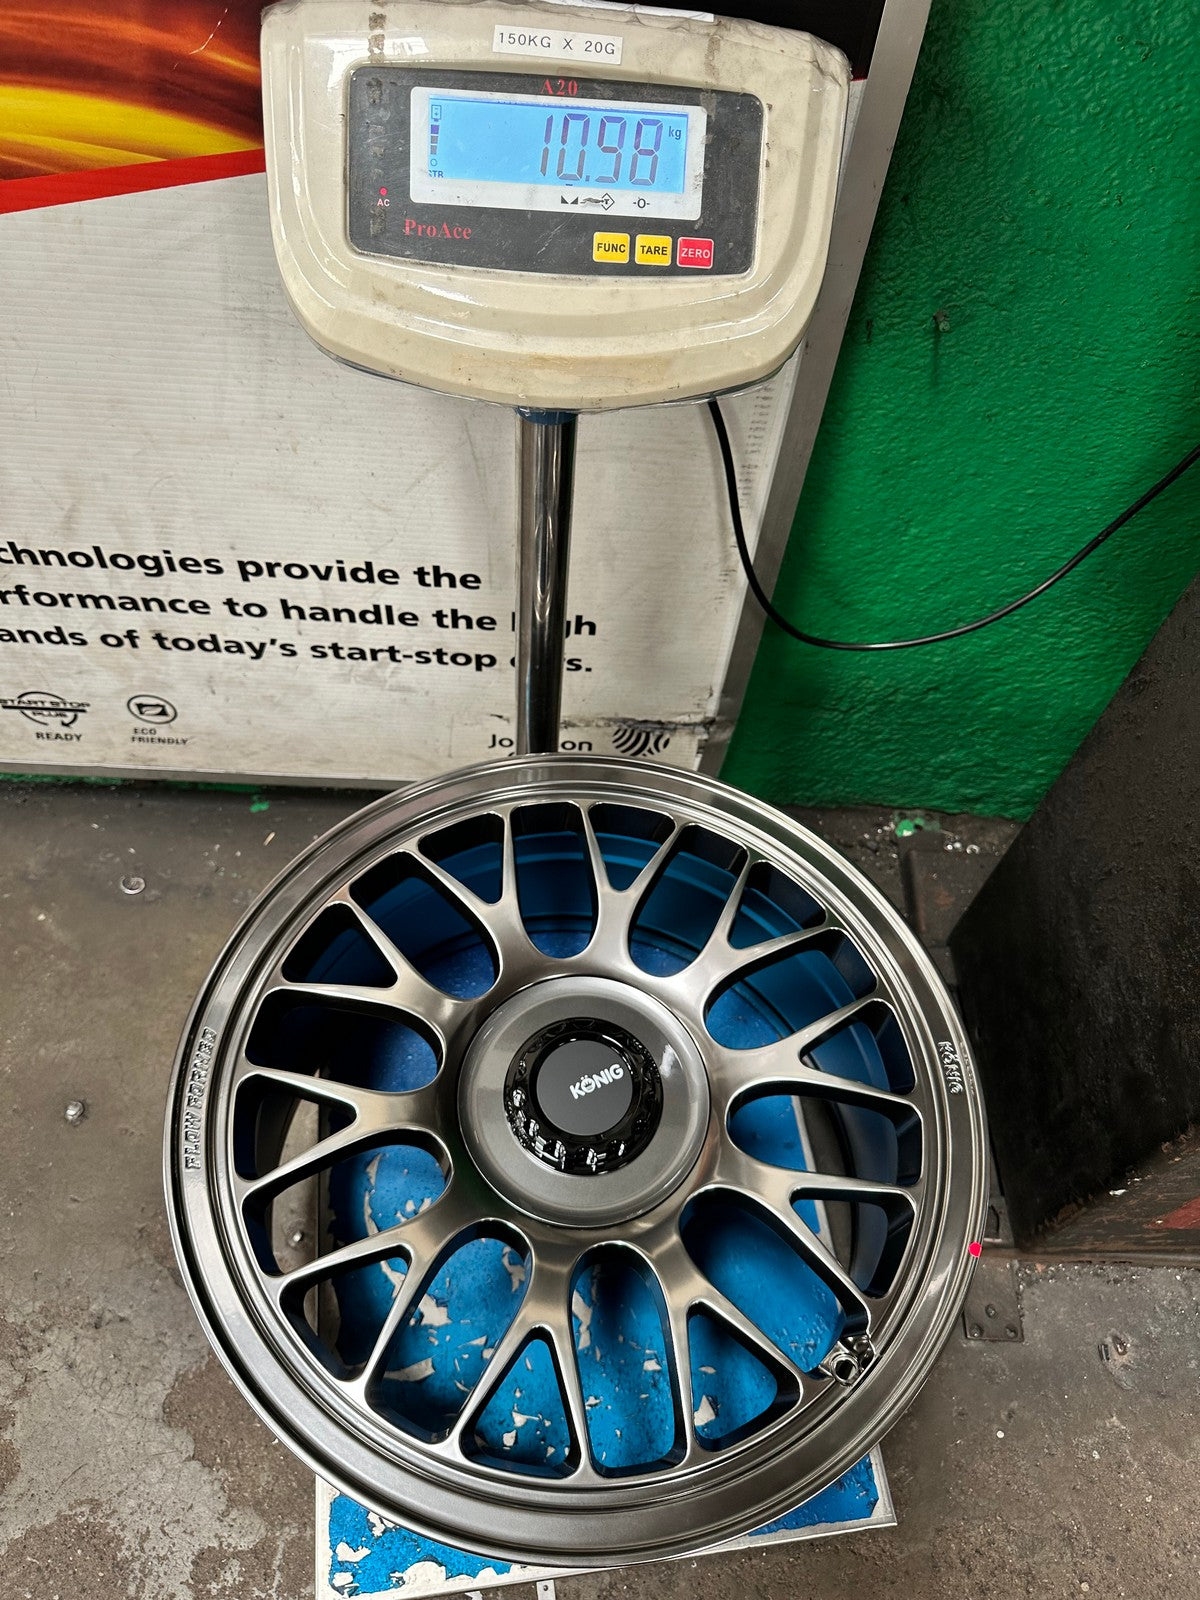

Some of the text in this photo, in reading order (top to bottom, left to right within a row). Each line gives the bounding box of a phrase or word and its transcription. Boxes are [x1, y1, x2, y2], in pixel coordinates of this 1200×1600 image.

[499, 32, 616, 55] 150KG X 20G
[540, 79, 578, 97] A20
[540, 112, 682, 186] 10.98 kg
[377, 199, 391, 207] AC
[404, 219, 472, 240] ProAce
[596, 242, 627, 254] FUNC
[639, 245, 668, 257] TARE
[681, 247, 711, 260] ZERO
[237, 559, 401, 585] provide
[413, 565, 482, 590] the
[223, 597, 268, 619] to
[279, 598, 419, 627] handle
[432, 608, 498, 632] the
[100, 629, 140, 649] of
[152, 632, 298, 660] today's
[310, 641, 497, 672] start-stop
[35, 732, 82, 742] READY
[131, 736, 189, 746] FRIENDLY
[133, 727, 157, 736] ECO
[569, 1063, 624, 1100] KÖNIG
[184, 1110, 202, 1170] FLOW
